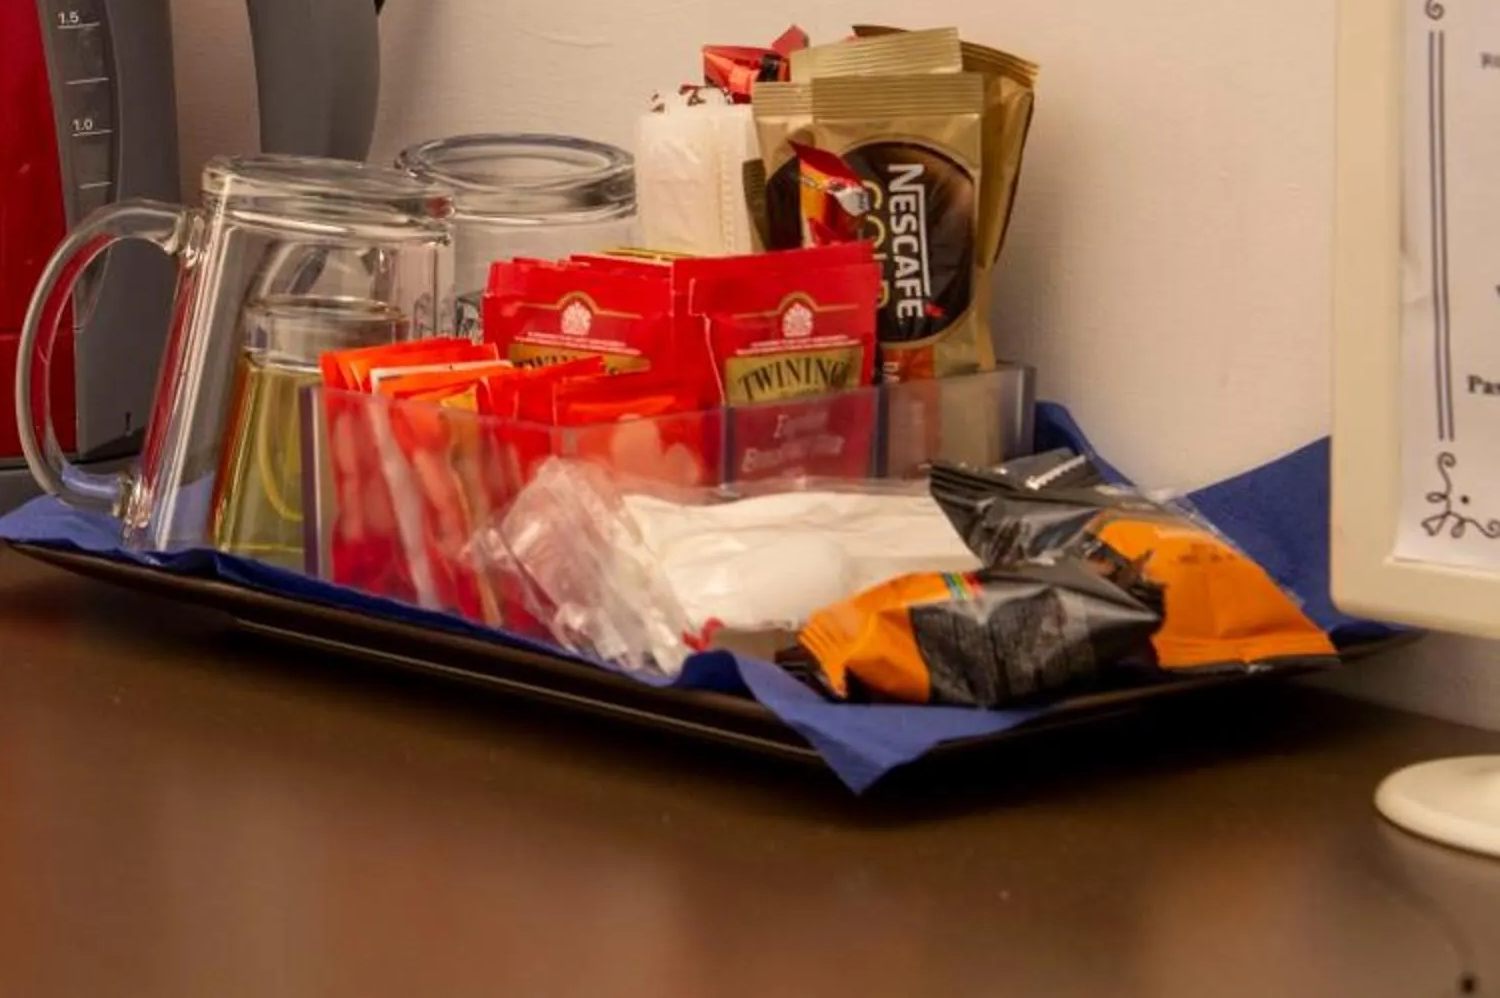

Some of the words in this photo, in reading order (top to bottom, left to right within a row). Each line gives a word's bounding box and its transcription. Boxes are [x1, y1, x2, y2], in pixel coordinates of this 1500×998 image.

[58, 11, 80, 25] 1.5
[72, 118, 93, 132] 1.0
[738, 356, 853, 401] TWINING
